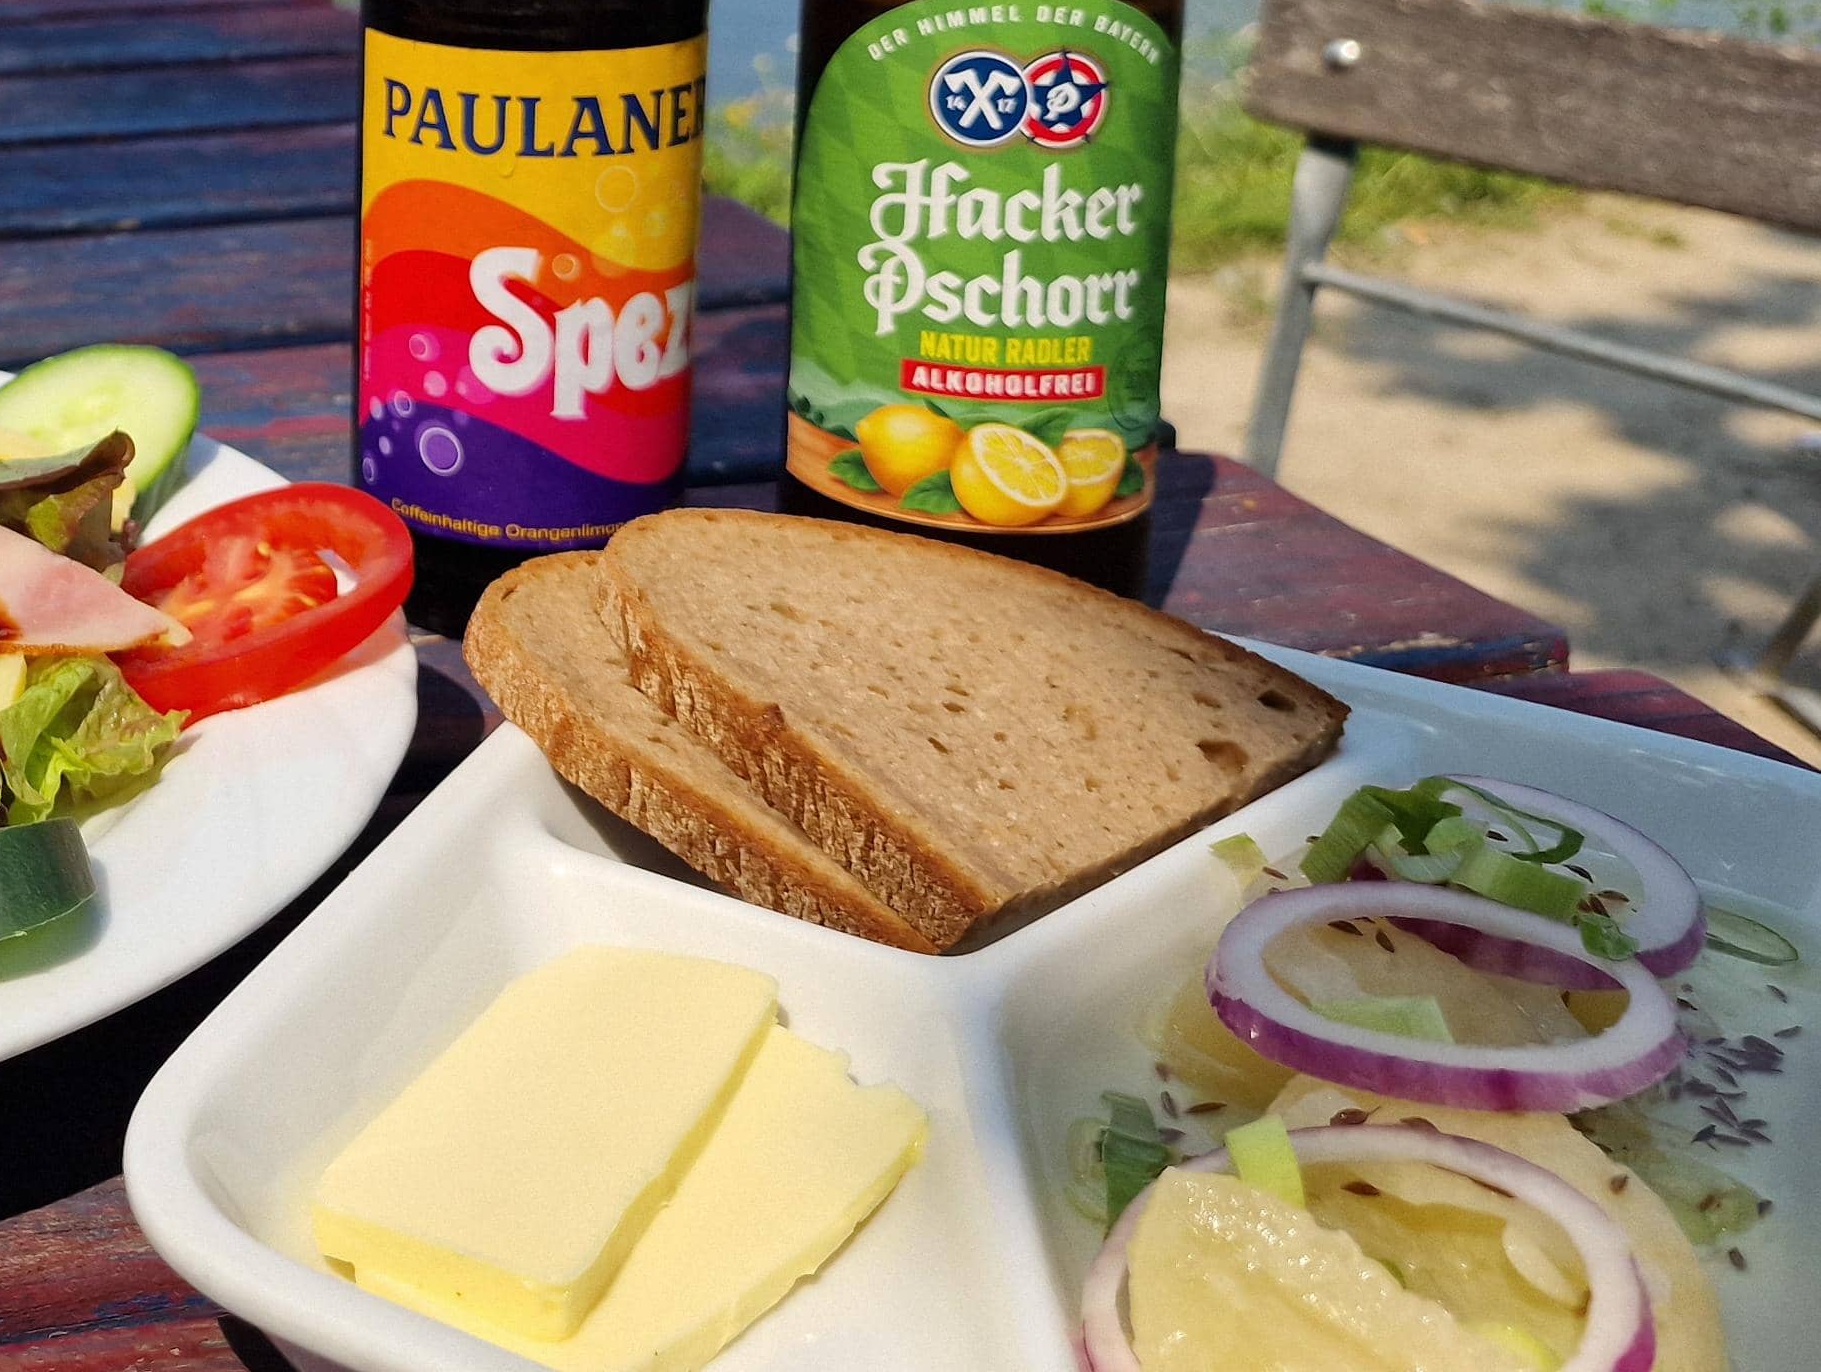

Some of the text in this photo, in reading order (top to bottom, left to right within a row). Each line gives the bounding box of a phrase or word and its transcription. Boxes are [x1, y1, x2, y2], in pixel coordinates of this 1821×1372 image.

[867, 4, 1160, 65] DER HIMMEL DER BAYERN
[869, 158, 1144, 244] Hacker
[858, 239, 1140, 336] Pschorr
[920, 330, 1093, 366] NATUR RADLER
[911, 364, 1096, 398] ALKOHOLFREI
[391, 496, 500, 540] Coffeinhaltige
